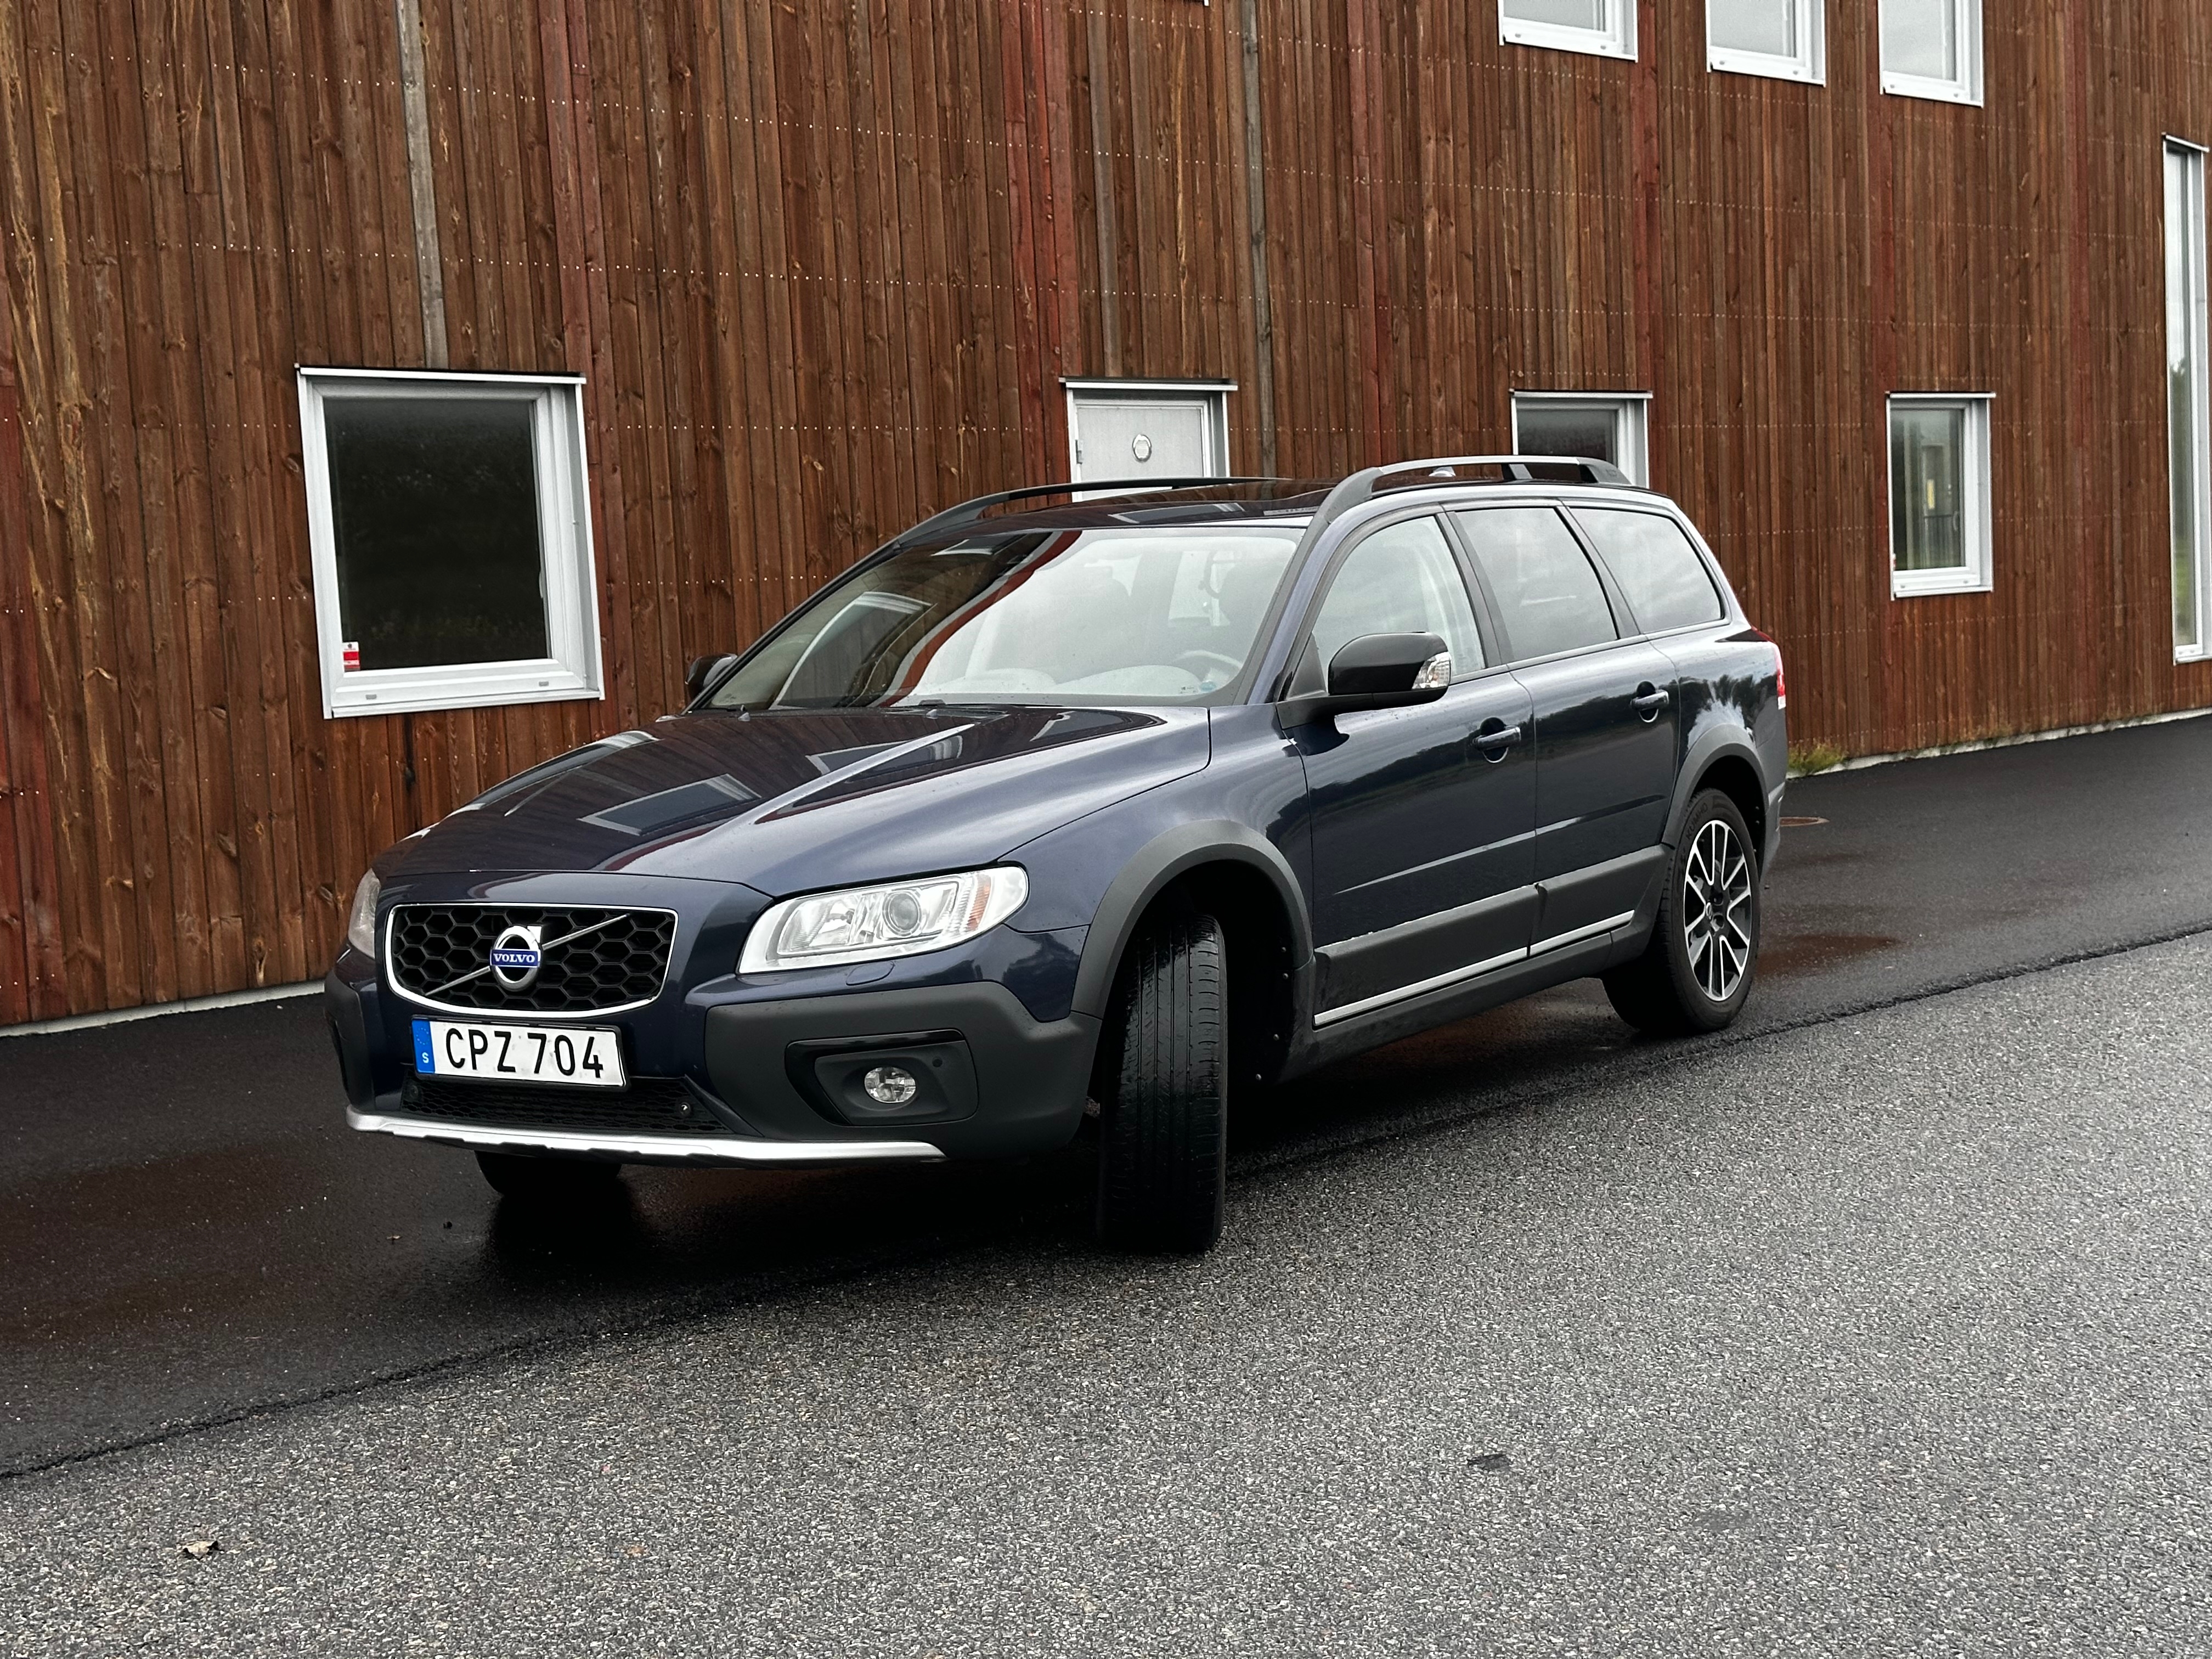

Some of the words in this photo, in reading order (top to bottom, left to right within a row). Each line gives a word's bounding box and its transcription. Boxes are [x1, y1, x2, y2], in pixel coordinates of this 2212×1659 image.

[493, 953, 535, 963] VOLVO
[422, 1052, 429, 1063] S
[446, 1028, 516, 1073] CPZ
[527, 1032, 603, 1077] 704
